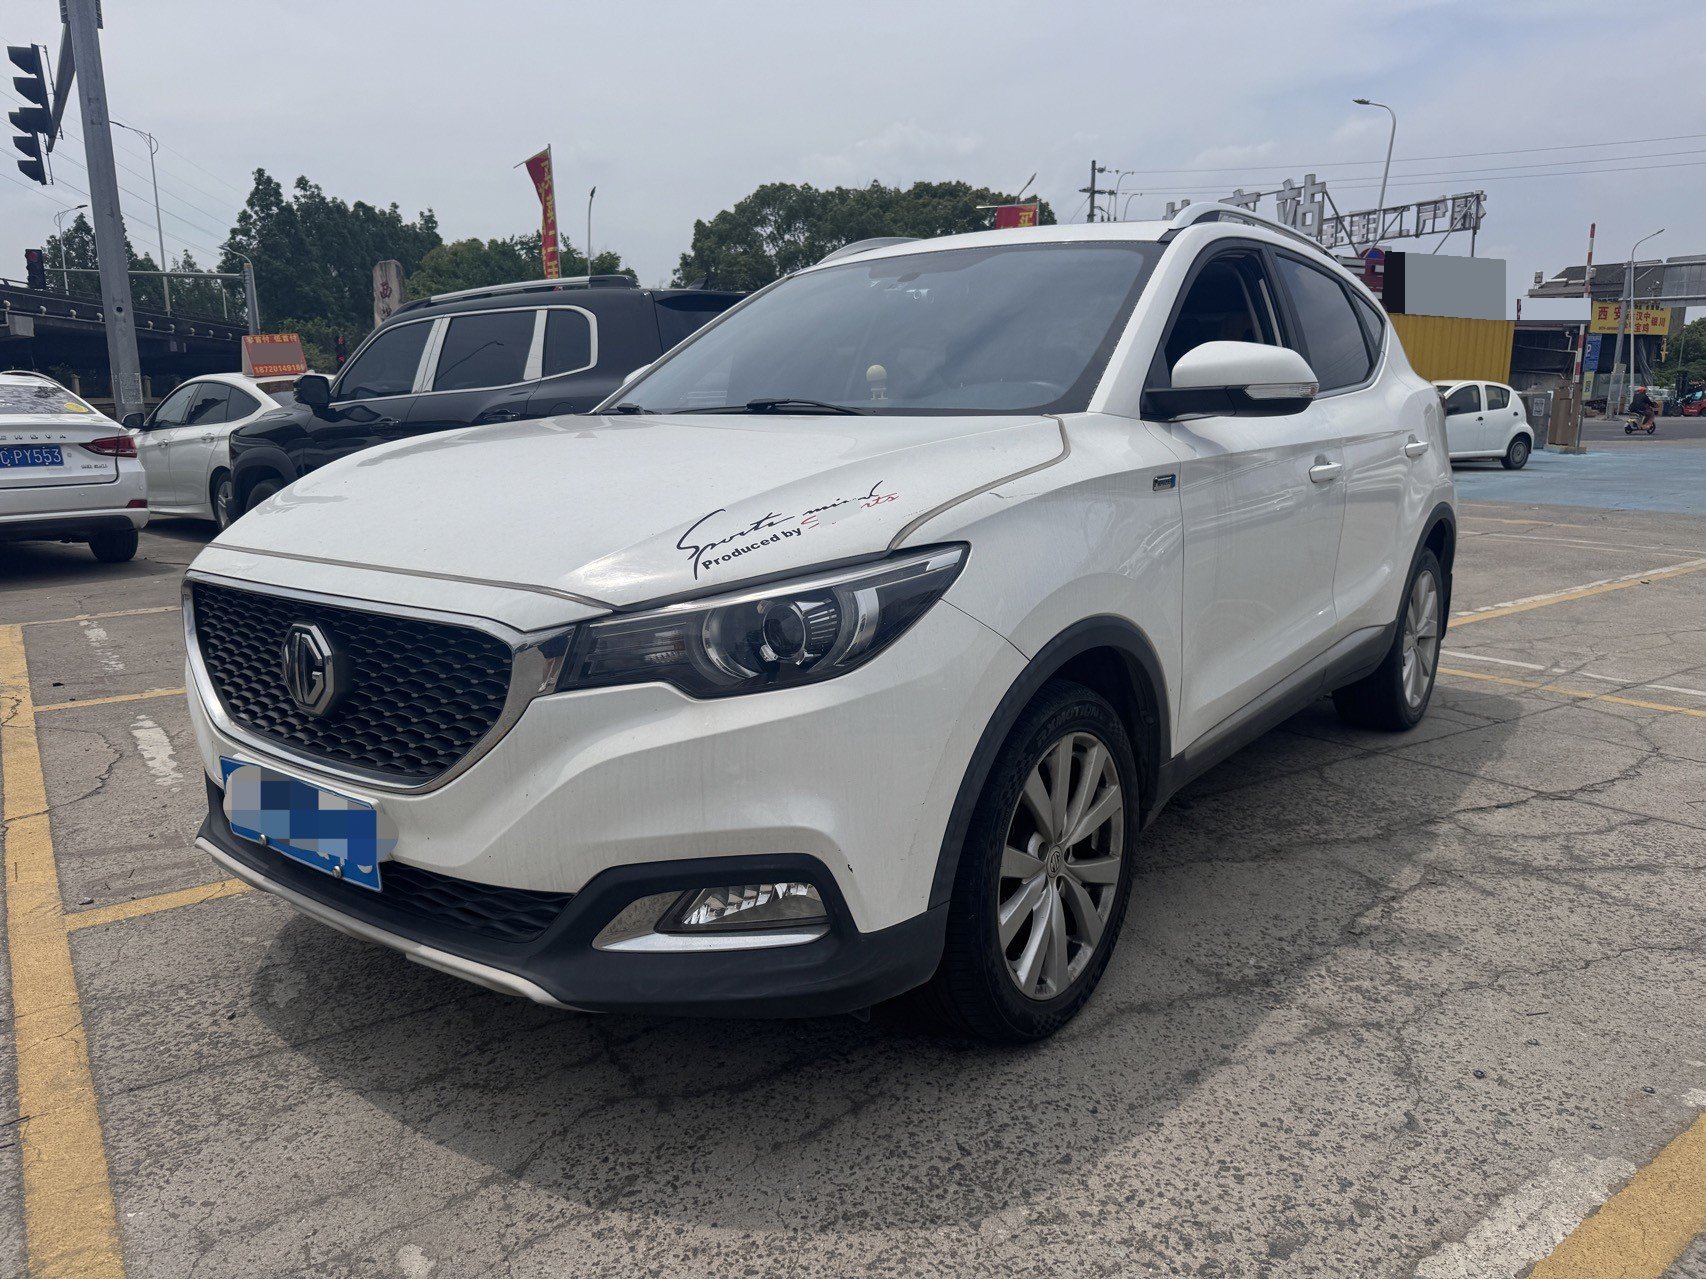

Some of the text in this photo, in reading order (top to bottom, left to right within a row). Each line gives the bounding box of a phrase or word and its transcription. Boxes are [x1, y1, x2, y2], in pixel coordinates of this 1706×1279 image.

[675, 508, 796, 580] Sports
[701, 533, 780, 571] Produced
[783, 526, 803, 541] by
